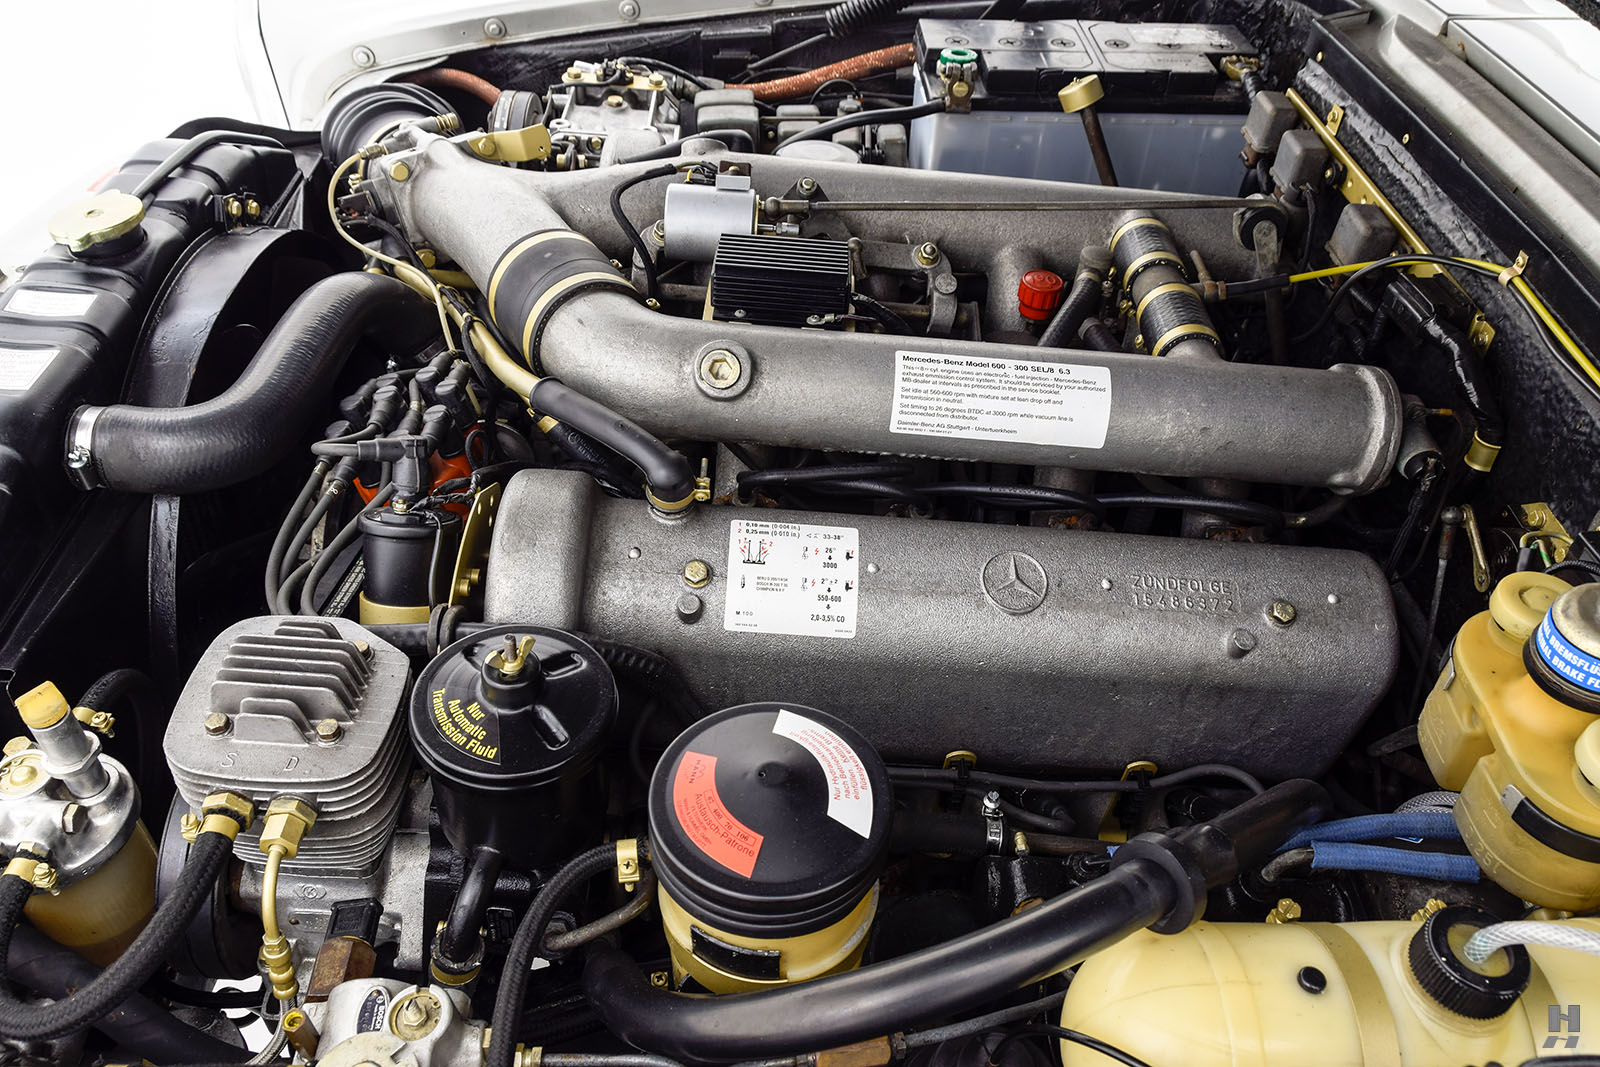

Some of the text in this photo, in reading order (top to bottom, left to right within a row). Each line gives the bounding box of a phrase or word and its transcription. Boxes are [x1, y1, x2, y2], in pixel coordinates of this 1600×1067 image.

[902, 355, 964, 366] Mercedes-Benz
[1131, 574, 1232, 595] ZÜNDFOLGE
[818, 594, 841, 602] 550-600
[1552, 655, 1586, 682] BRAKE
[448, 699, 486, 740] Automatic
[466, 702, 486, 721] Nur
[432, 688, 498, 759] Transmission Fluid
[220, 752, 300, 772] S D
[695, 794, 755, 858] Austausch-Patrone
[375, 1005, 385, 1029] BOSCH
